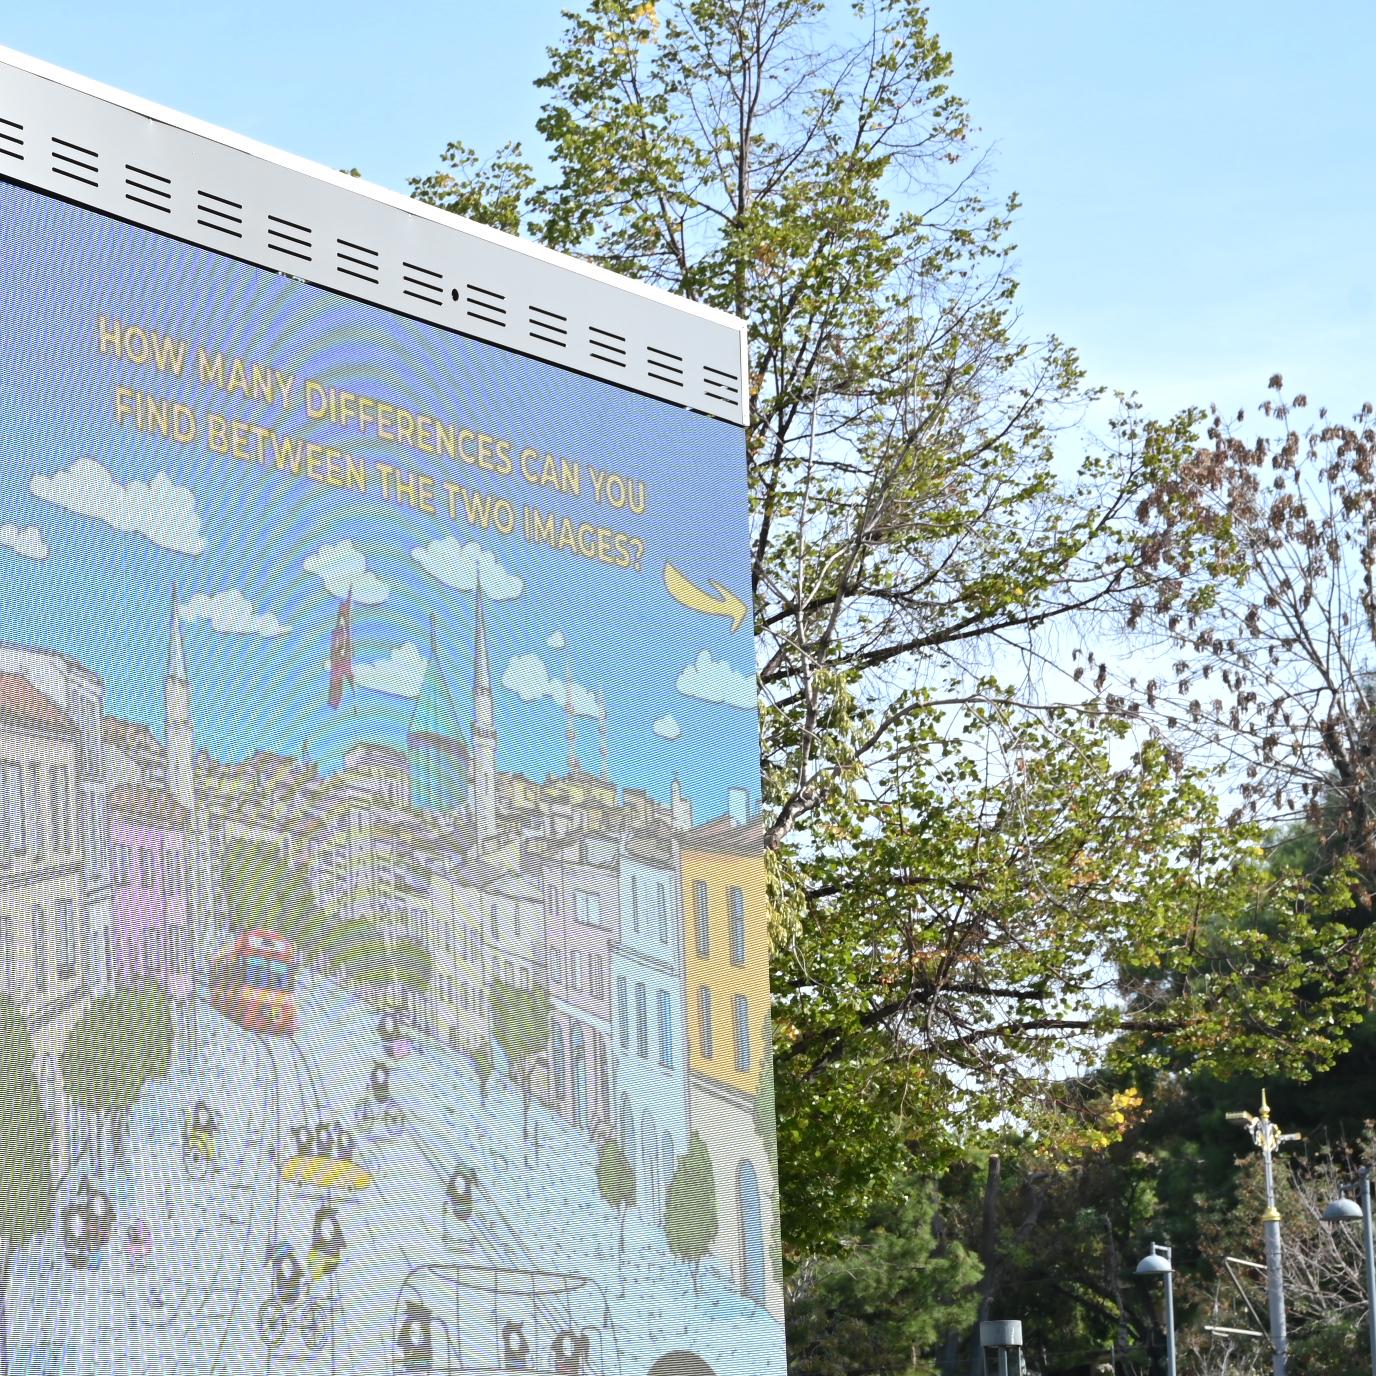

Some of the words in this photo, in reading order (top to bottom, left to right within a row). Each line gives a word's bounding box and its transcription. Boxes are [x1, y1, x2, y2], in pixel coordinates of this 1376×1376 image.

[98, 314, 186, 377] HOW
[197, 347, 294, 407] MANY
[305, 380, 513, 475] DIFFERENCES
[520, 449, 580, 497] CAN
[587, 465, 646, 515] YOU
[114, 386, 198, 446] FIND
[207, 416, 368, 494] BETWEEN
[376, 462, 435, 517] THE
[444, 482, 517, 536] TWO
[523, 505, 646, 574] IMAGES?
